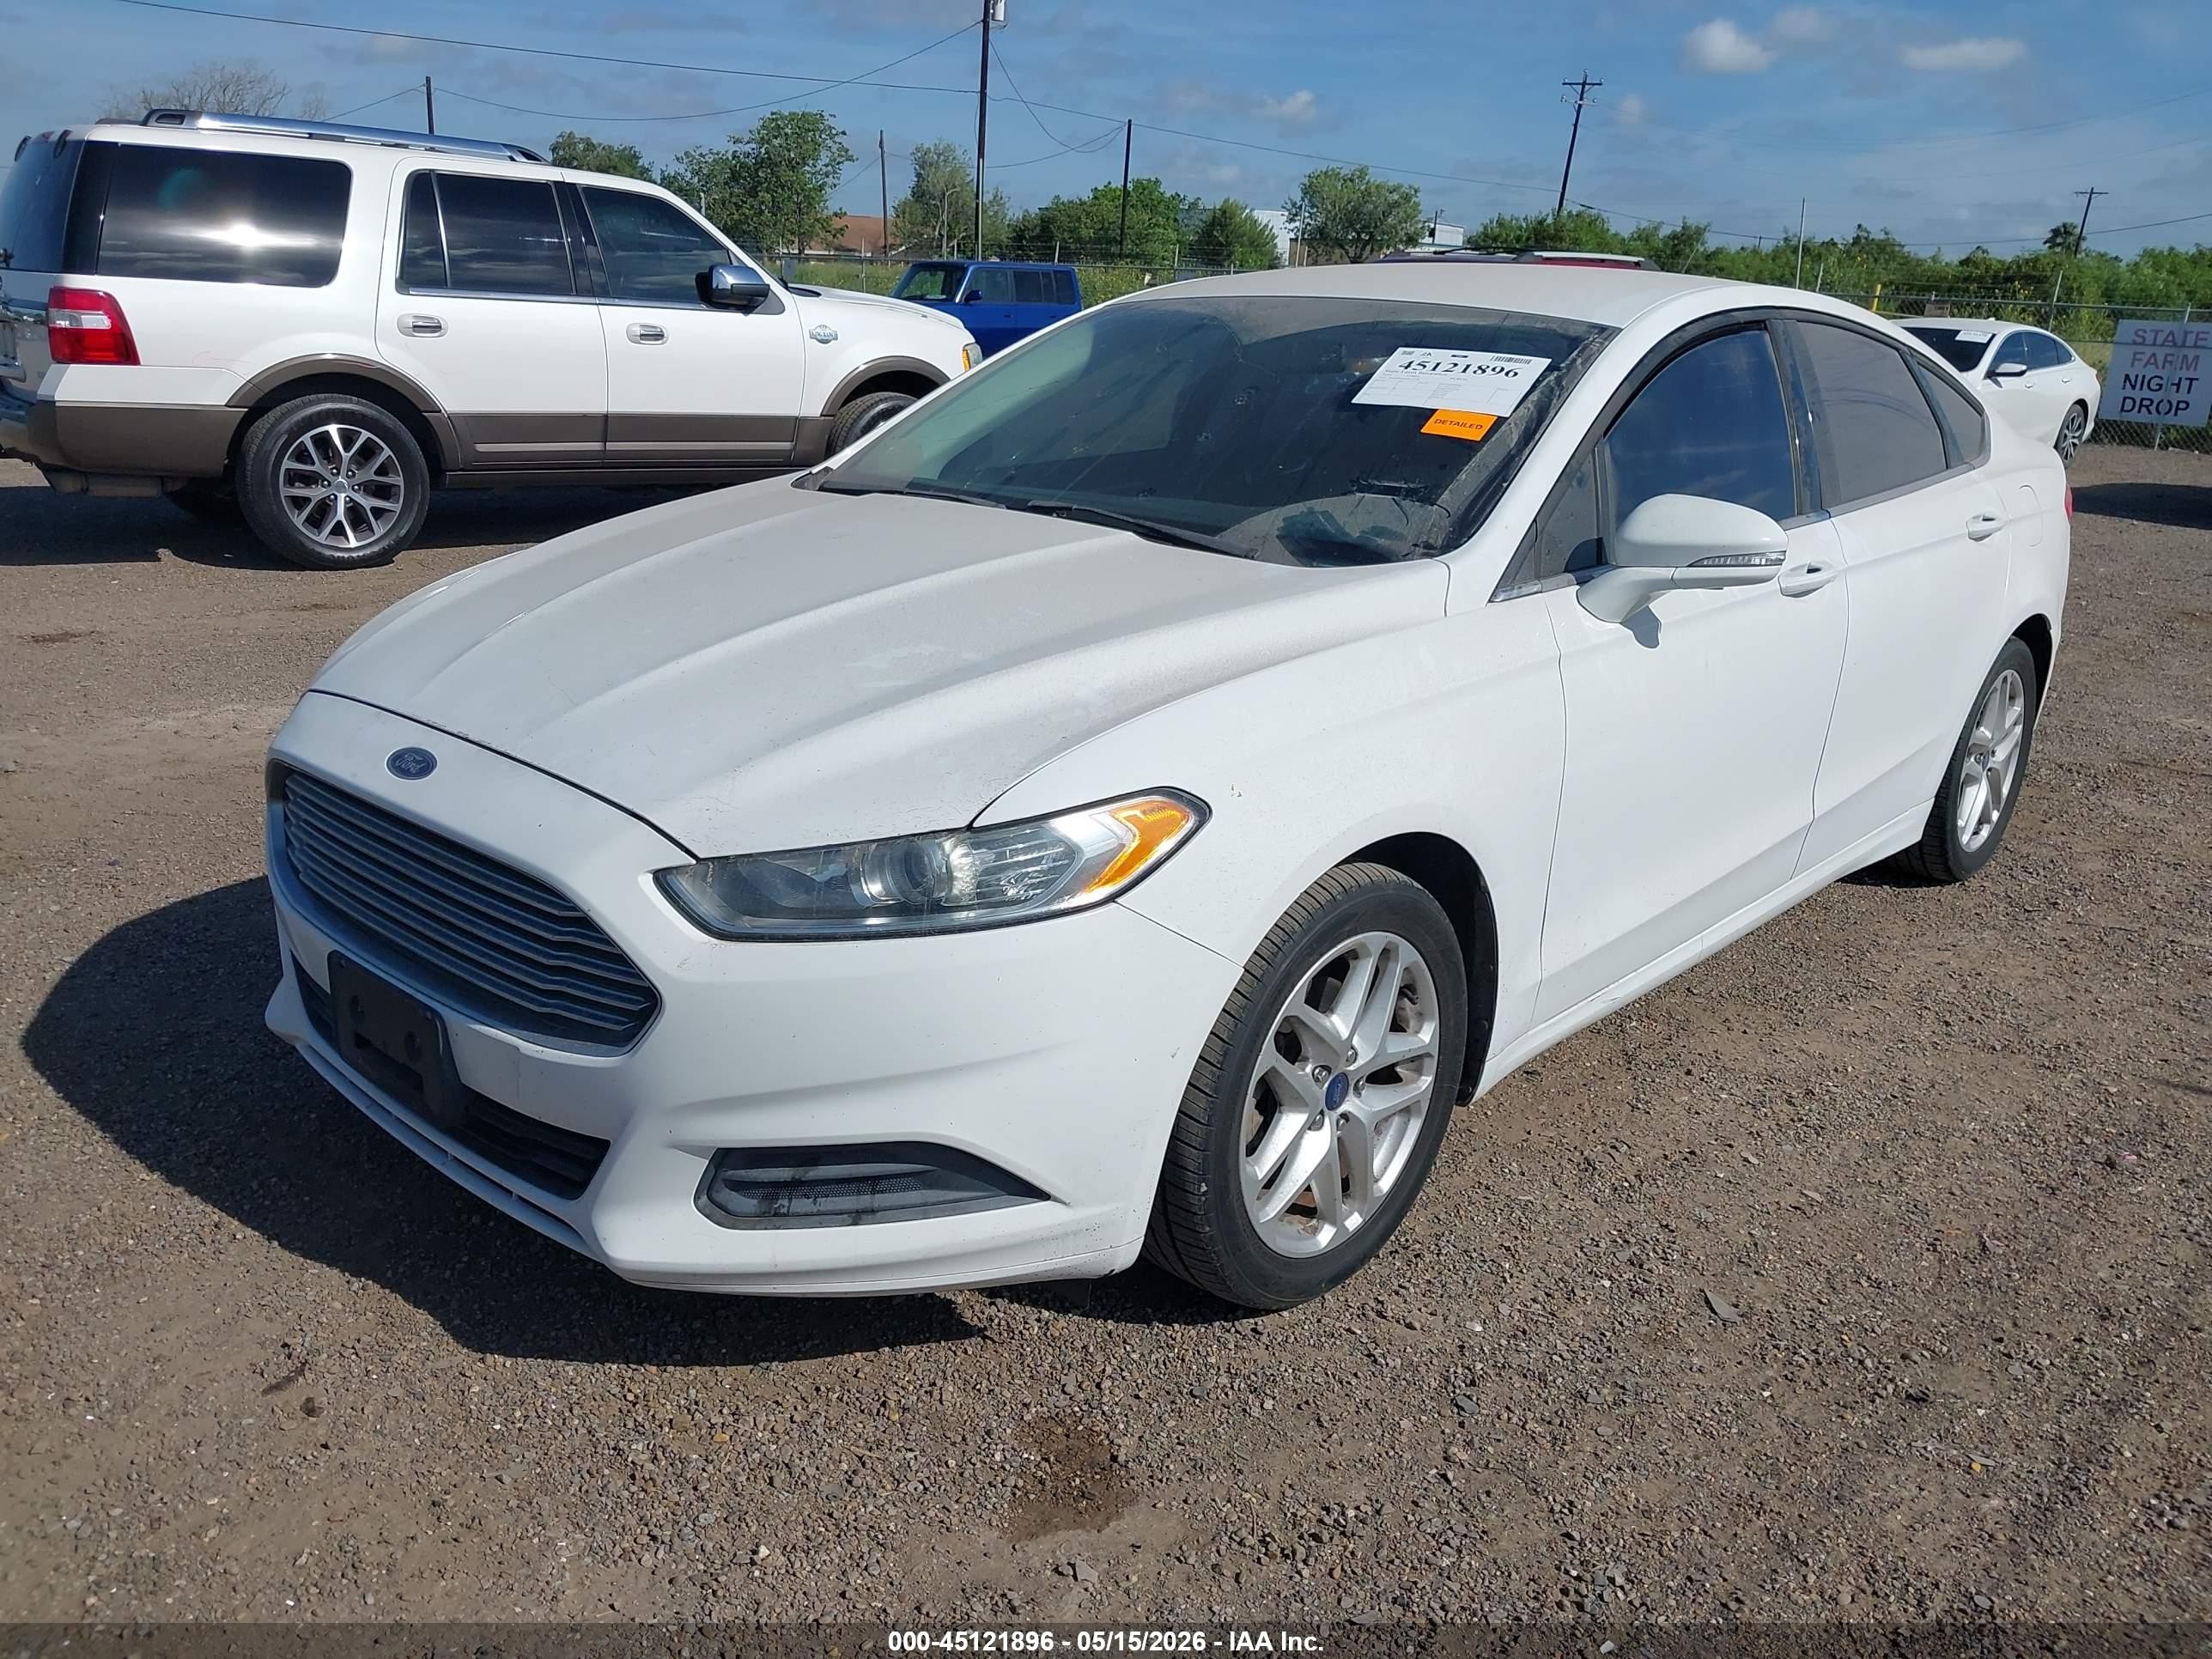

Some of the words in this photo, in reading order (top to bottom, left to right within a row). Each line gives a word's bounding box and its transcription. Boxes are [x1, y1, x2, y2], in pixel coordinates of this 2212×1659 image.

[2132, 328, 2210, 348] STATE
[1398, 359, 1523, 379] 45121896
[2130, 351, 2201, 372] FARM
[2122, 373, 2200, 394] NIGHT
[2119, 396, 2191, 417] DROP
[1434, 418, 1484, 430] DETAILED
[396, 752, 427, 773] Ford
